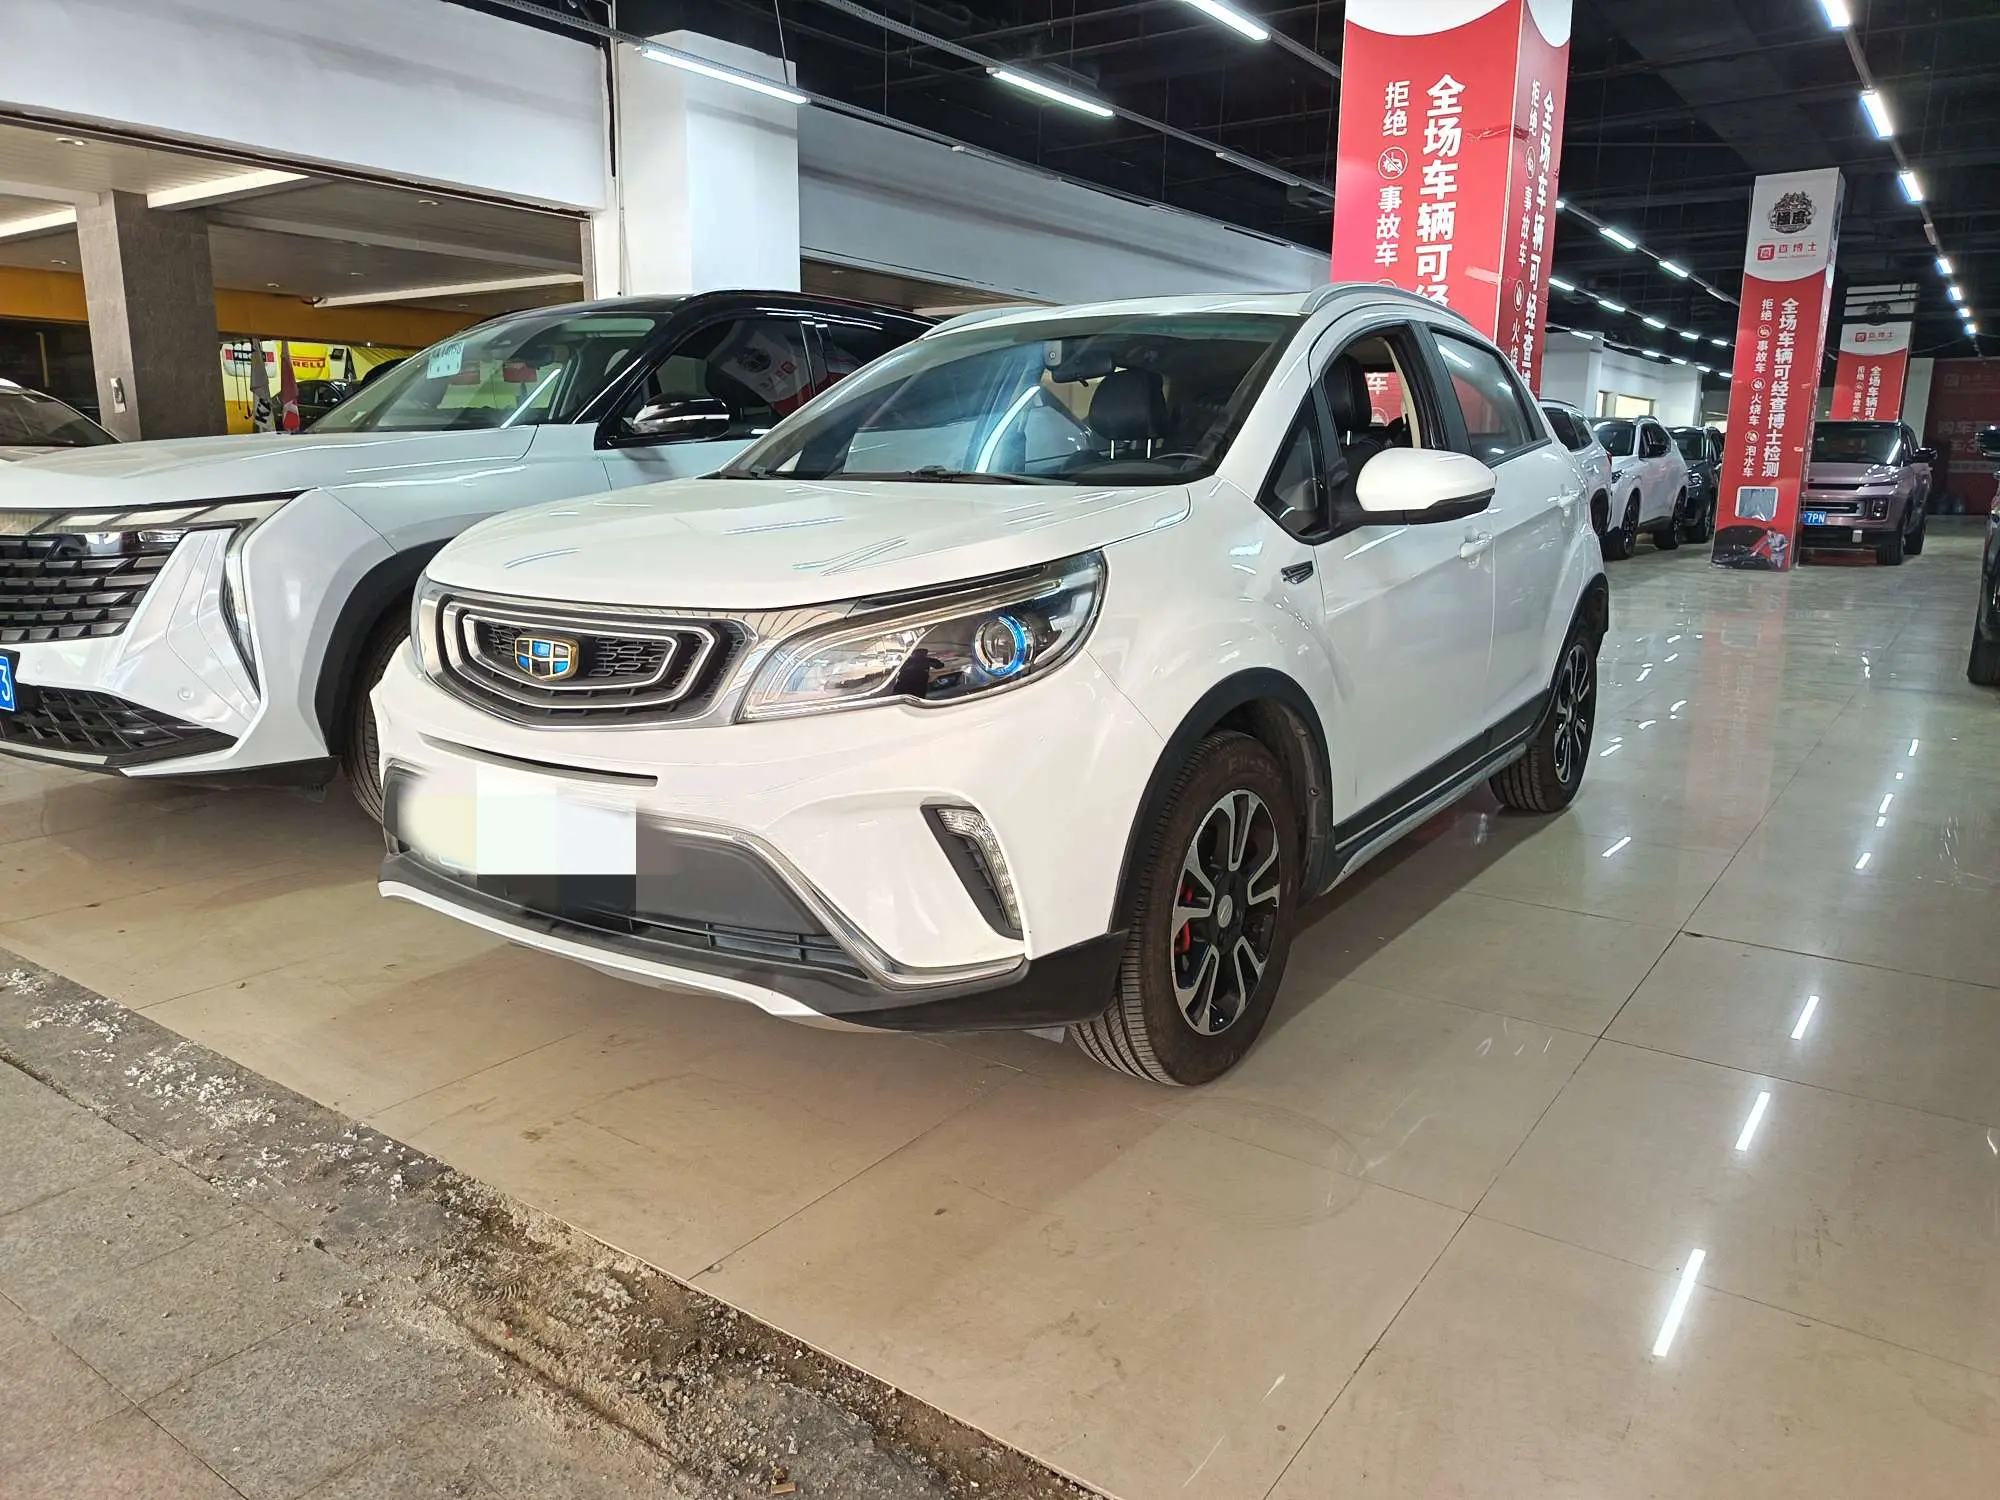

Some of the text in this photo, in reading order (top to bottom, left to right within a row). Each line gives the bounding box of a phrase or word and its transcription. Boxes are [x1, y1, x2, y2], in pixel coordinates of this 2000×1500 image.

[1374, 80, 1411, 268] 拒绝 事故车
[1518, 185, 1533, 268] 事故车
[292, 357, 326, 369] RELLI
[1365, 372, 1389, 395] 车
[1742, 298, 1774, 477] 拒绝 事故车 火烧车 泡水车
[1761, 297, 1800, 478] 全场车辆可经查博士检测
